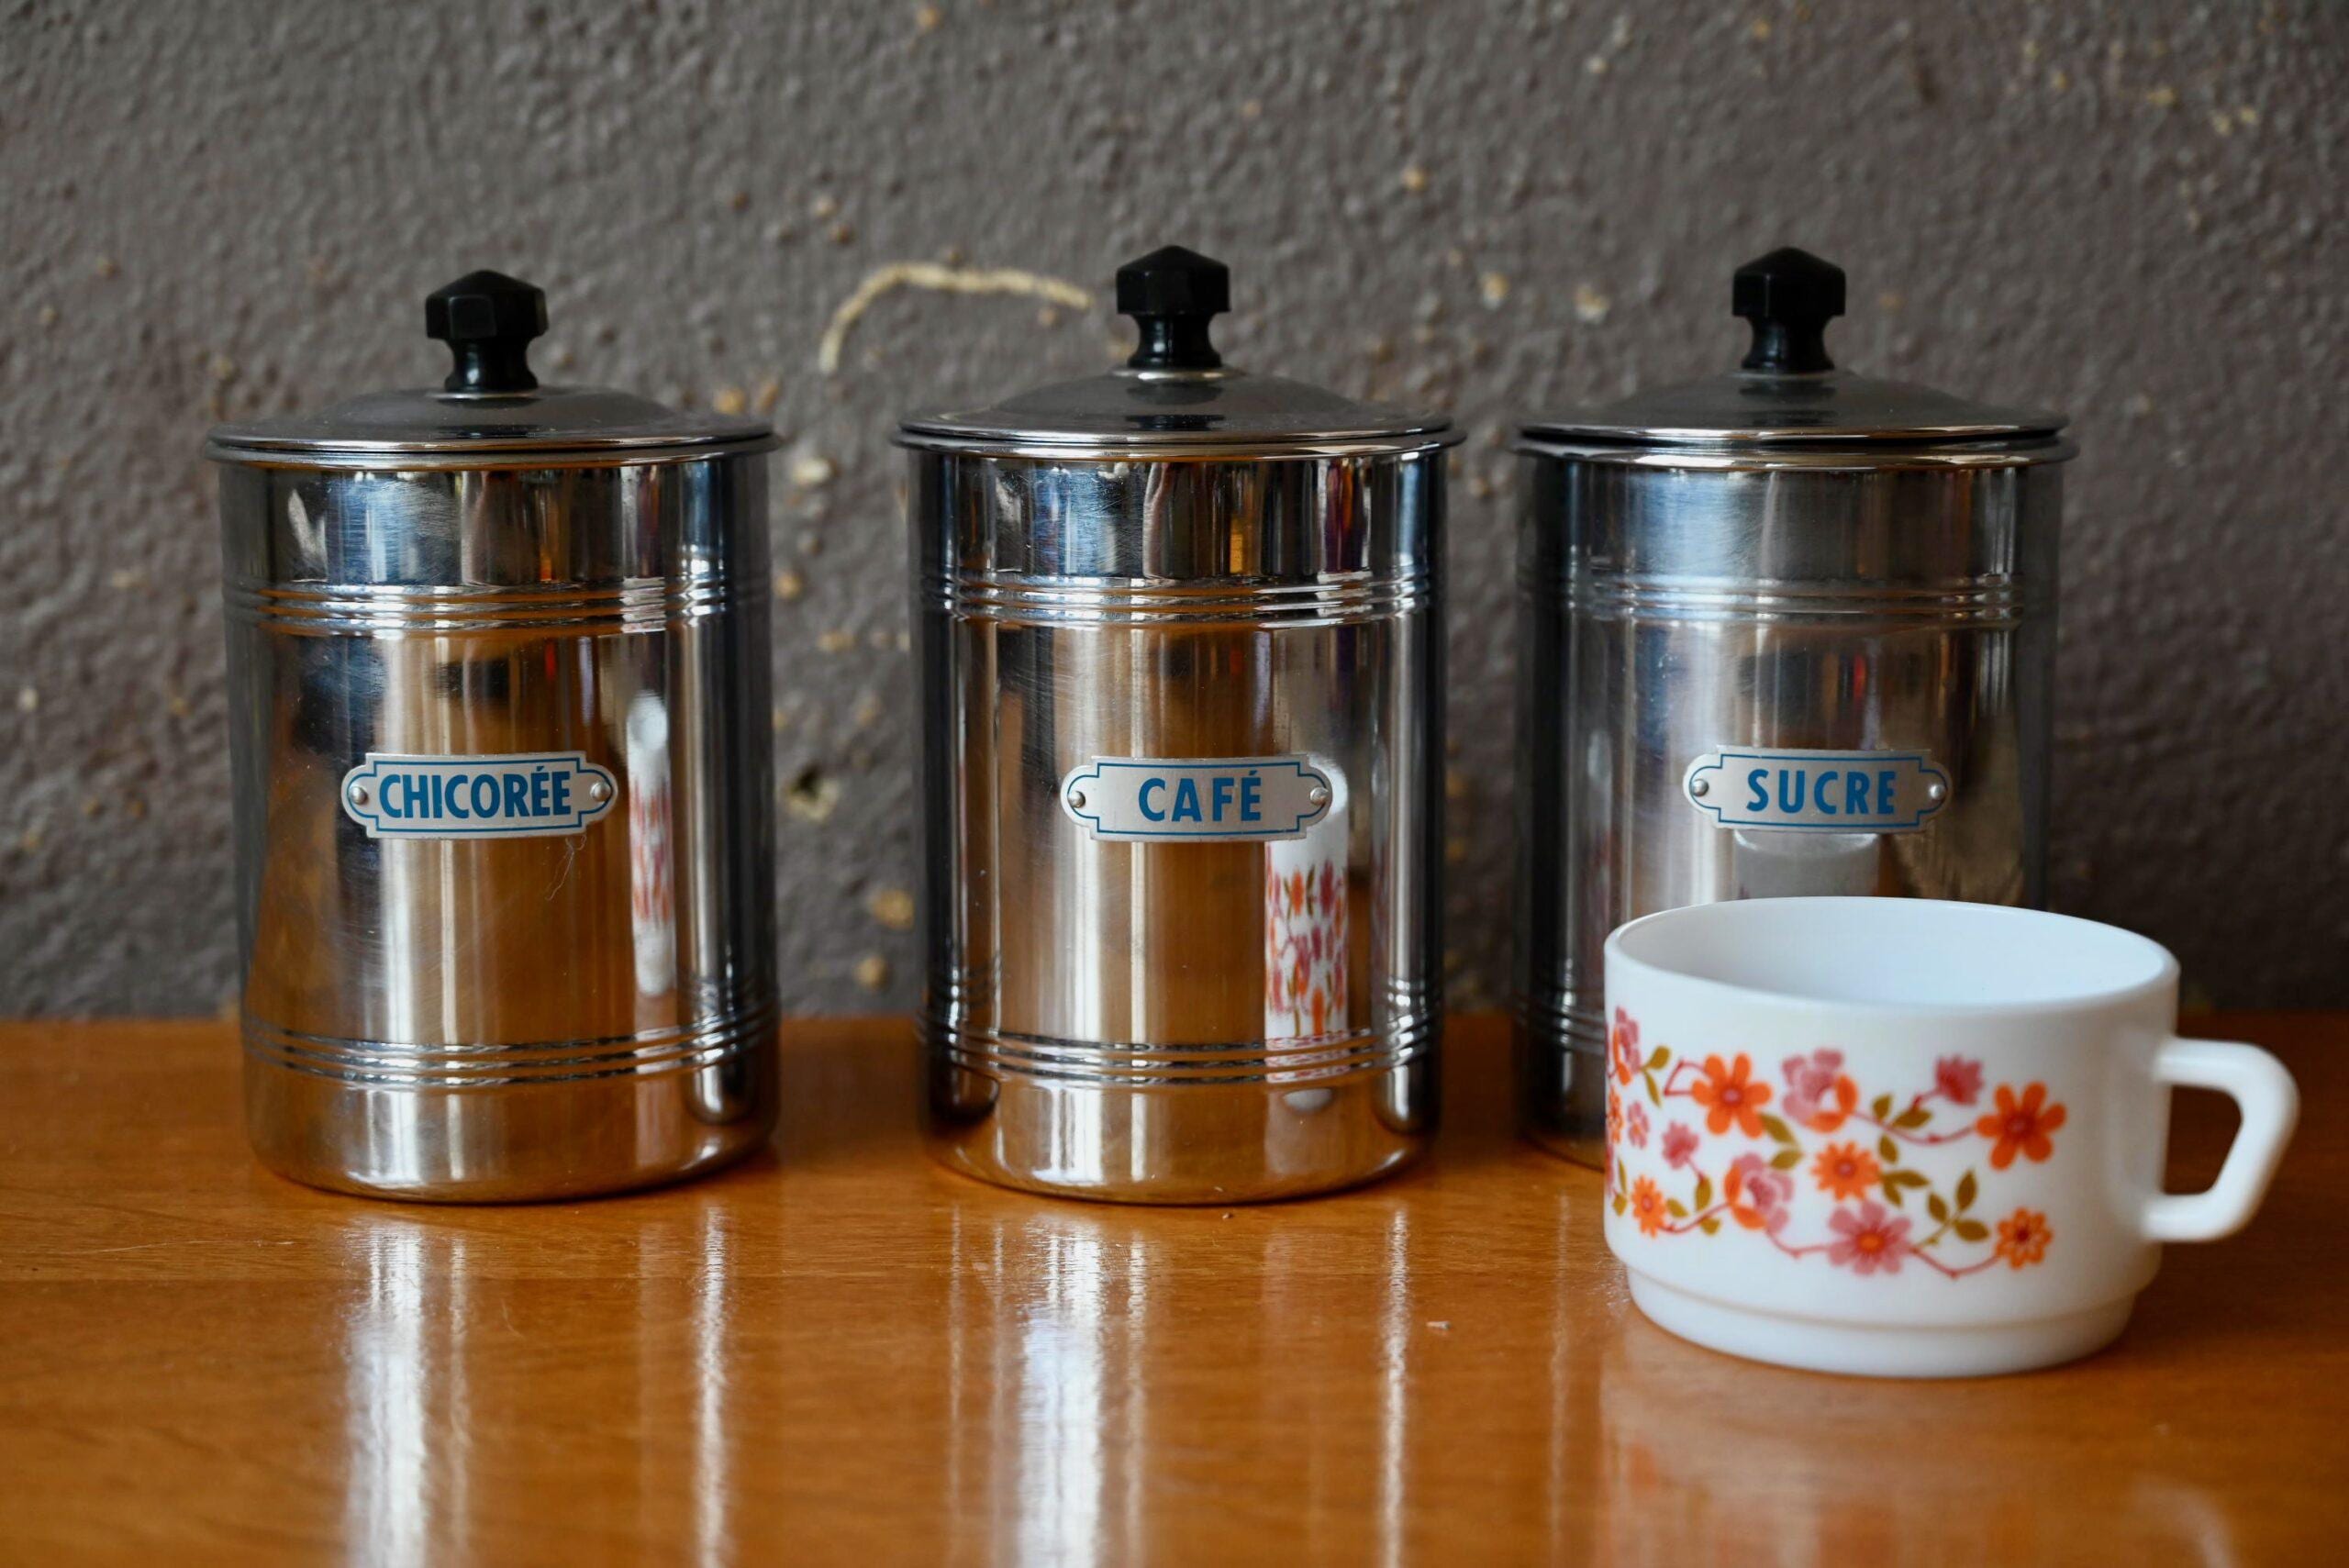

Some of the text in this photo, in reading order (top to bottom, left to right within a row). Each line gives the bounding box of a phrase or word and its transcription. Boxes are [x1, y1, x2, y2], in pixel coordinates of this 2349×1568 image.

[378, 765, 572, 819] CHICORÉE
[1138, 770, 1262, 822] CAFÉ
[1746, 769, 1897, 815] SUCRE
